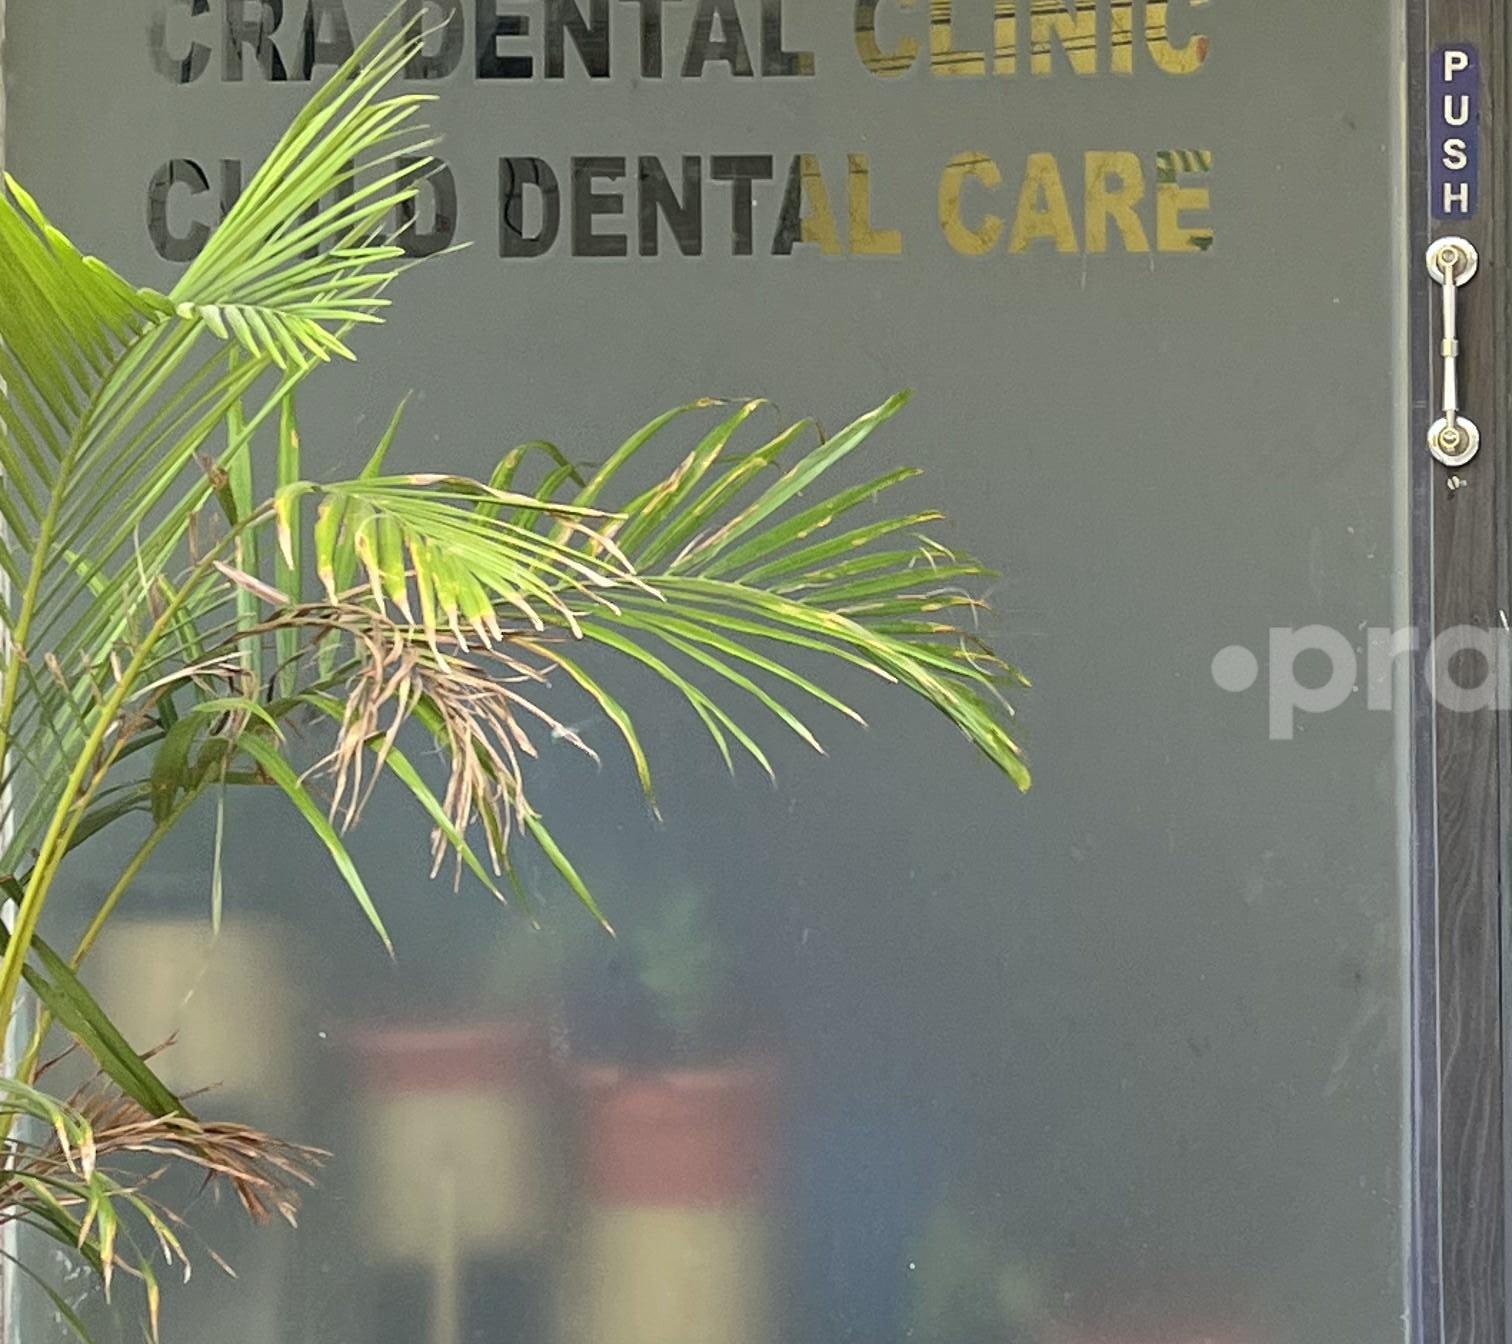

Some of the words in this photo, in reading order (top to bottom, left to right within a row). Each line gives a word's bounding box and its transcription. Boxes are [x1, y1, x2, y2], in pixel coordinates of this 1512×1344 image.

[1442, 50, 1469, 213] PUSH
[500, 153, 902, 257] DENTAL
[938, 150, 1213, 255] CARE
